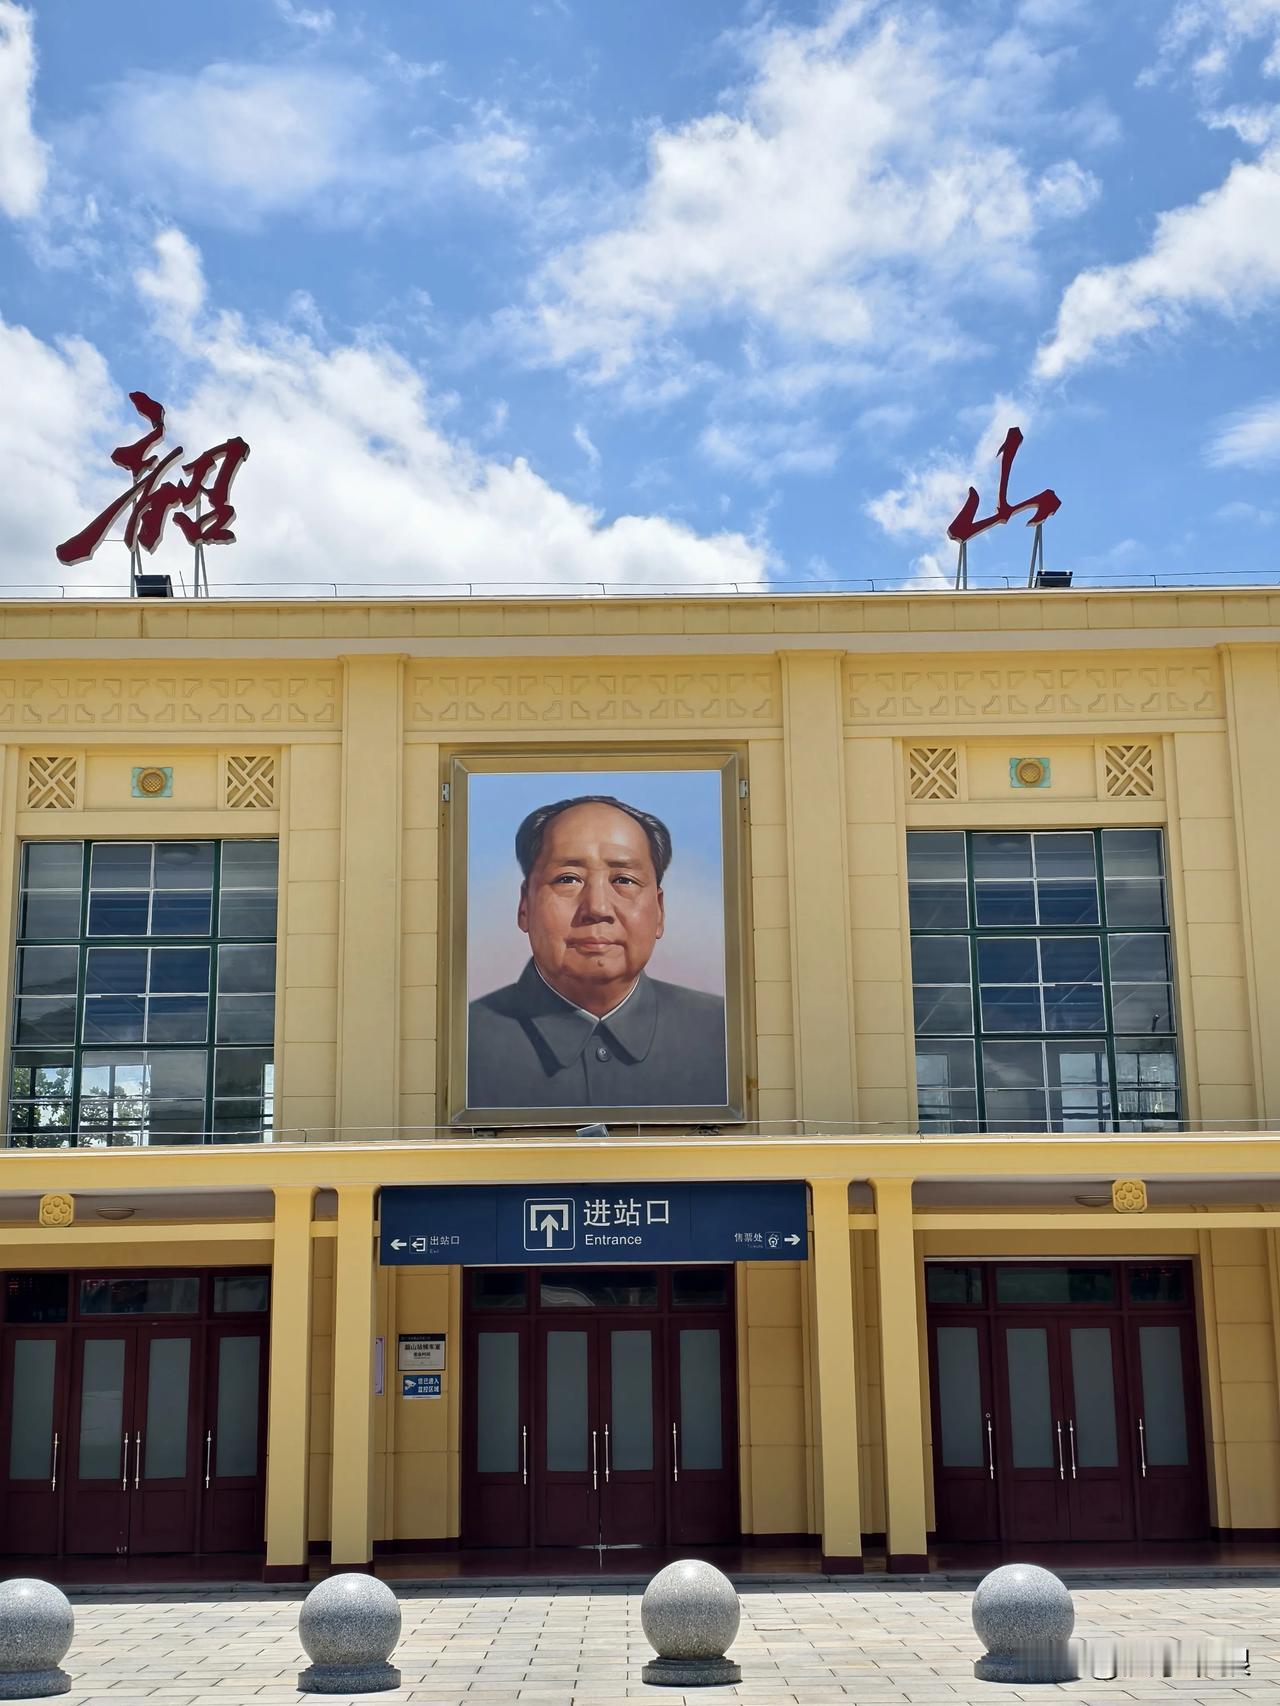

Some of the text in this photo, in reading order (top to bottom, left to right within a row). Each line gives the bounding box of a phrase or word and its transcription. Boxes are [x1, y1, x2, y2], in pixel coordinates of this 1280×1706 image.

[947, 426, 1062, 544] 山
[583, 1198, 669, 1227] 进站口
[430, 1235, 460, 1246] 出站口
[585, 1234, 642, 1246] Entrance
[734, 1232, 763, 1243] 售票处
